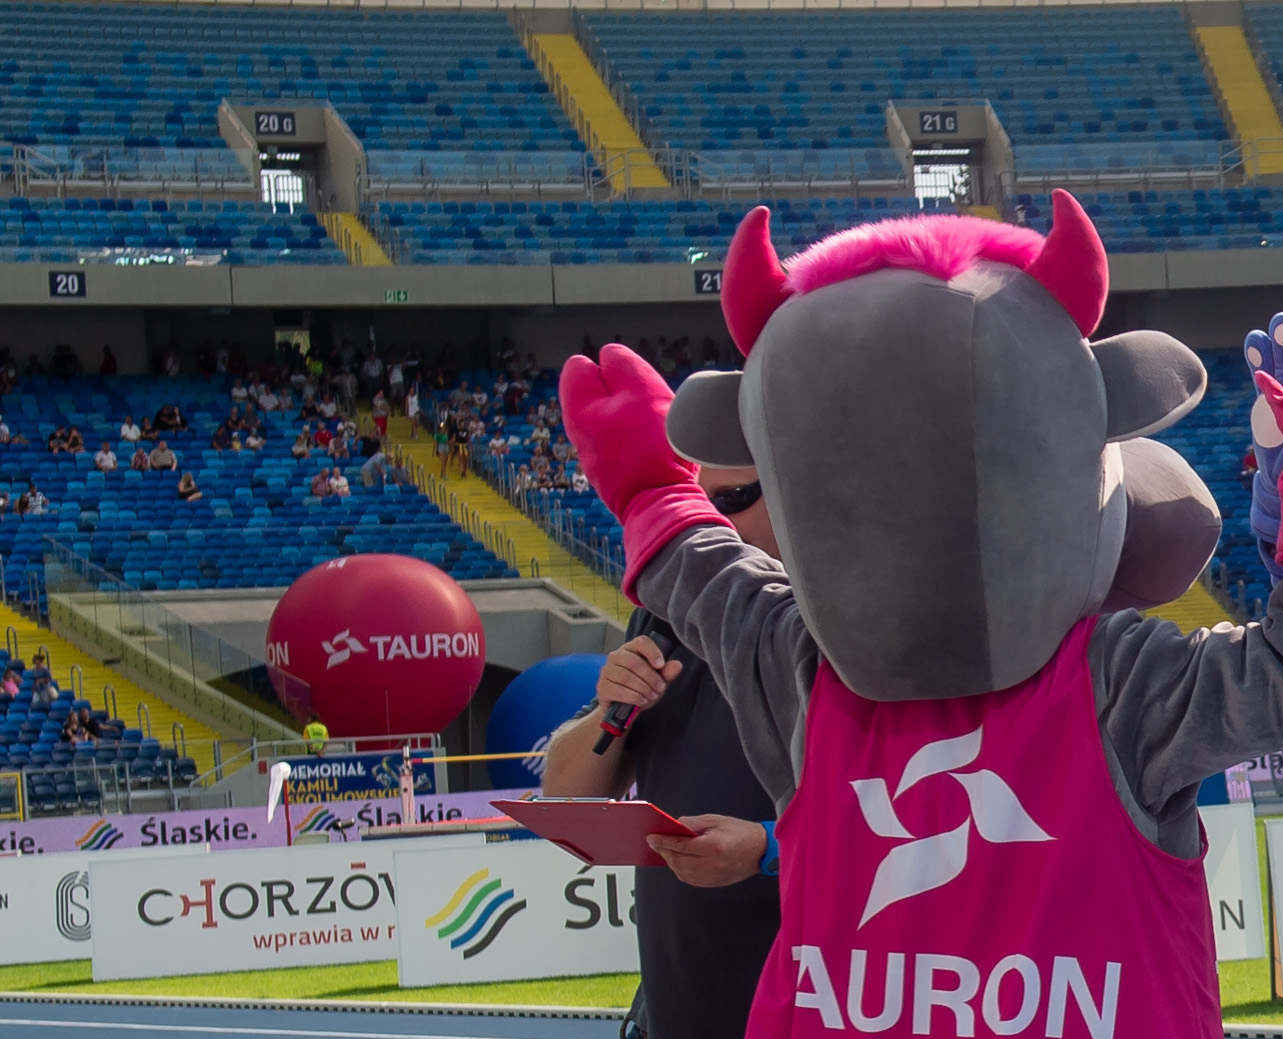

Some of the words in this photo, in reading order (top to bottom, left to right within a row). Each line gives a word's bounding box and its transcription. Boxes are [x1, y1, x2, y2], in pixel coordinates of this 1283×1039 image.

[258, 114, 279, 133] 20
[923, 114, 941, 131] 21
[945, 116, 956, 130] G
[56, 273, 79, 294] 20
[701, 273, 721, 291] 21
[265, 641, 290, 667] ON
[369, 632, 479, 661] TAURON
[287, 776, 339, 794] KAMILI
[252, 924, 353, 952] wprawia
[360, 925, 380, 941] w
